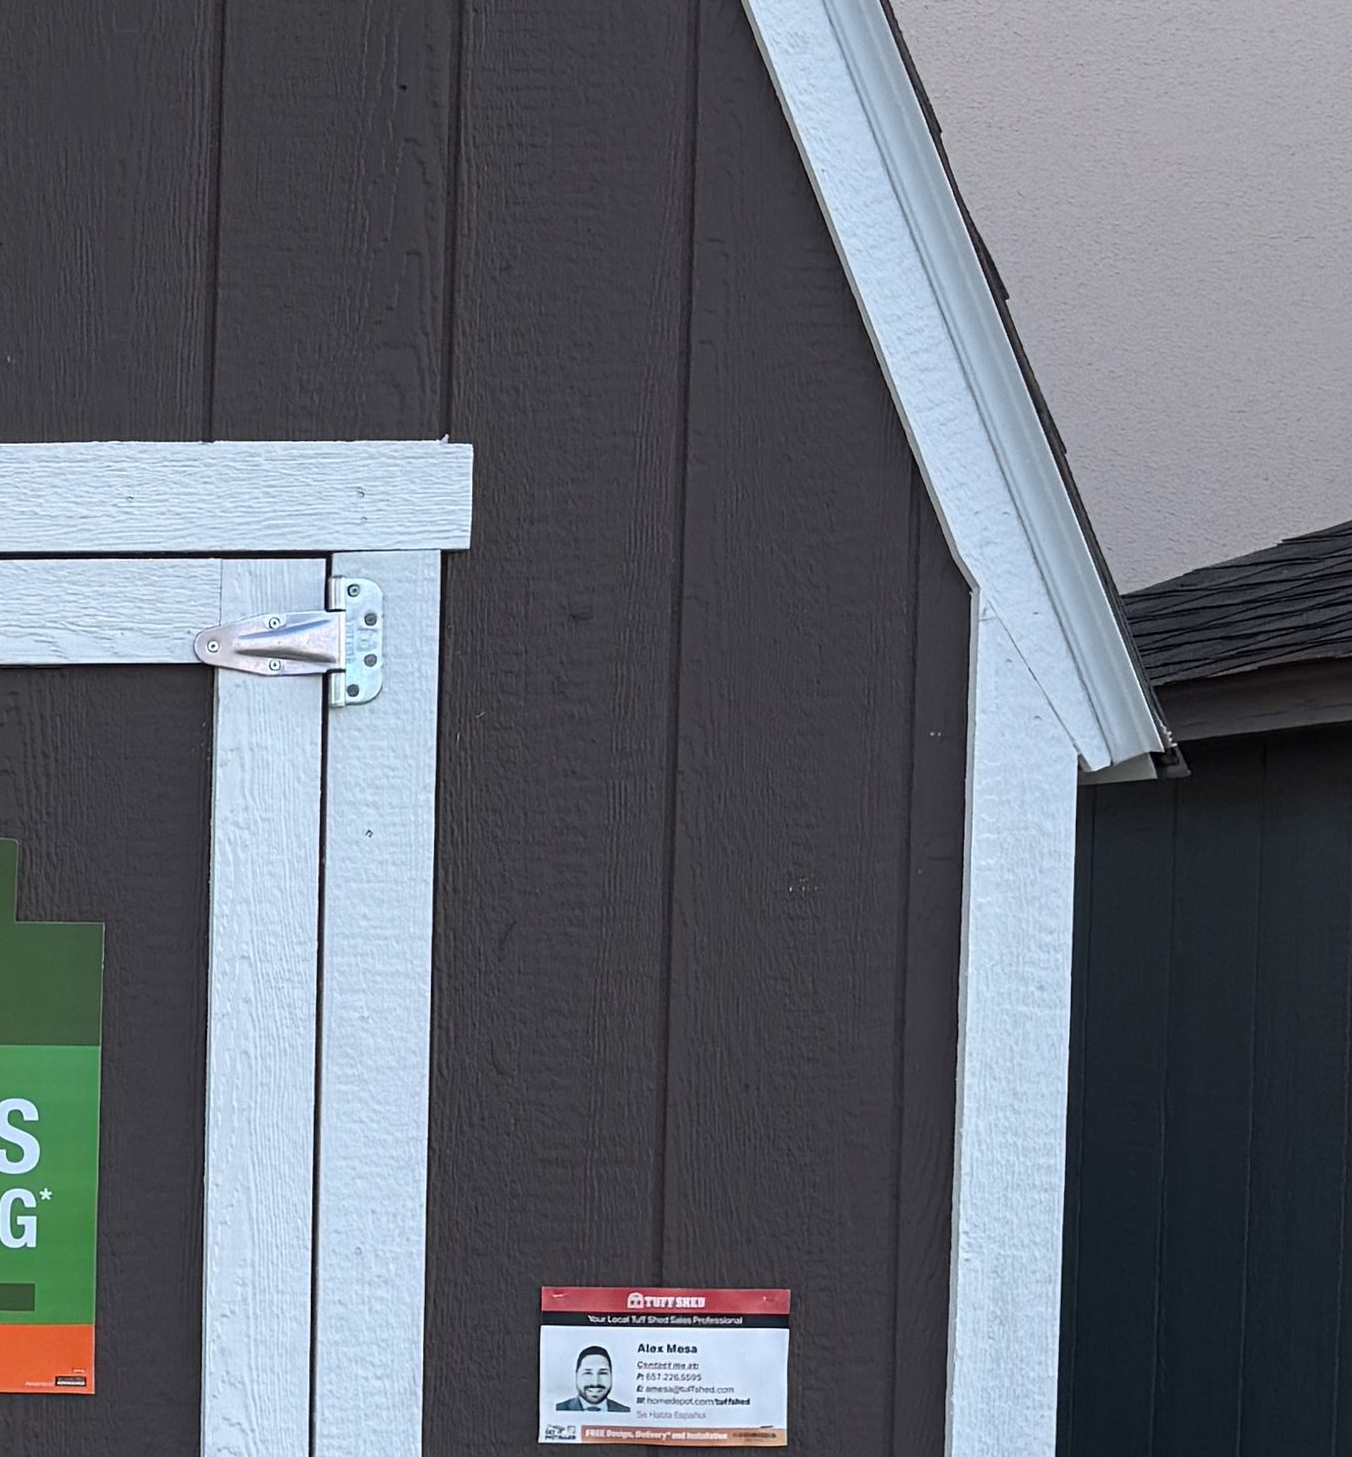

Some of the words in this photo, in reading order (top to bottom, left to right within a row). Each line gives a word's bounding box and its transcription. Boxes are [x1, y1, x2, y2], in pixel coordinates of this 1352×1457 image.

[587, 1314, 606, 1323] Your
[607, 1315, 630, 1323] Local
[631, 1315, 646, 1324] Tuff
[692, 1316, 743, 1325] Professional
[637, 1343, 664, 1354] Alex
